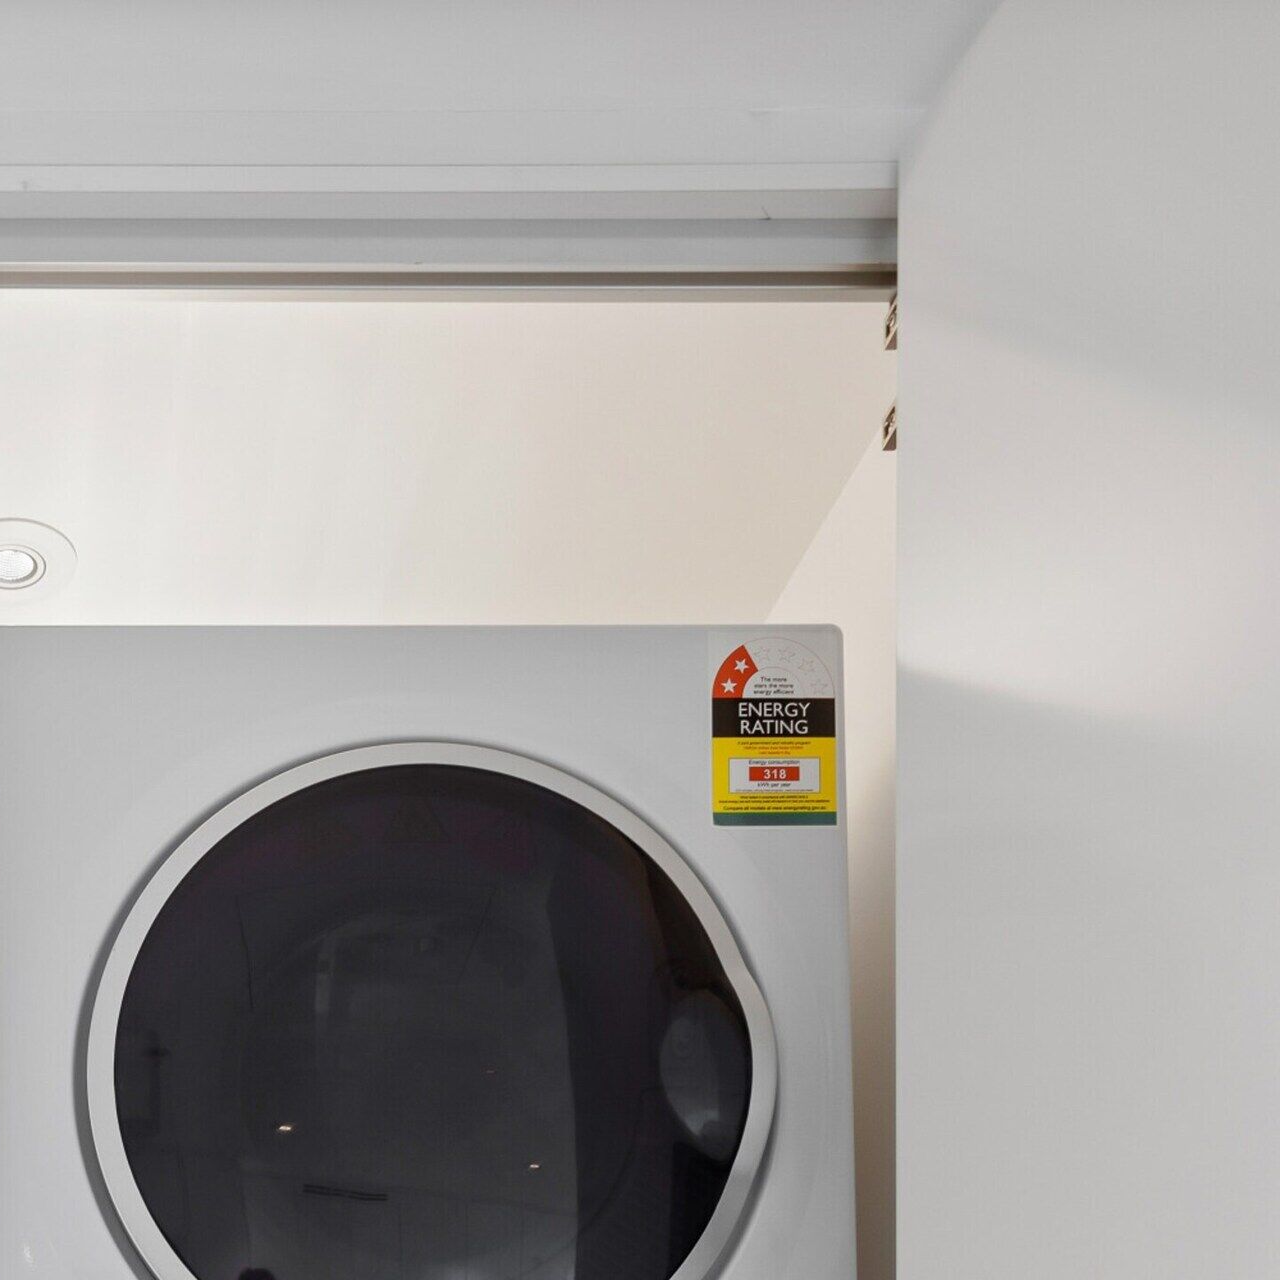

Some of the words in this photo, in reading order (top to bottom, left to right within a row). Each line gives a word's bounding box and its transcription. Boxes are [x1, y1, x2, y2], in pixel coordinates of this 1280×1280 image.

[738, 702, 811, 717] ENERGY
[740, 719, 809, 734] RATING
[764, 769, 786, 779] 318
